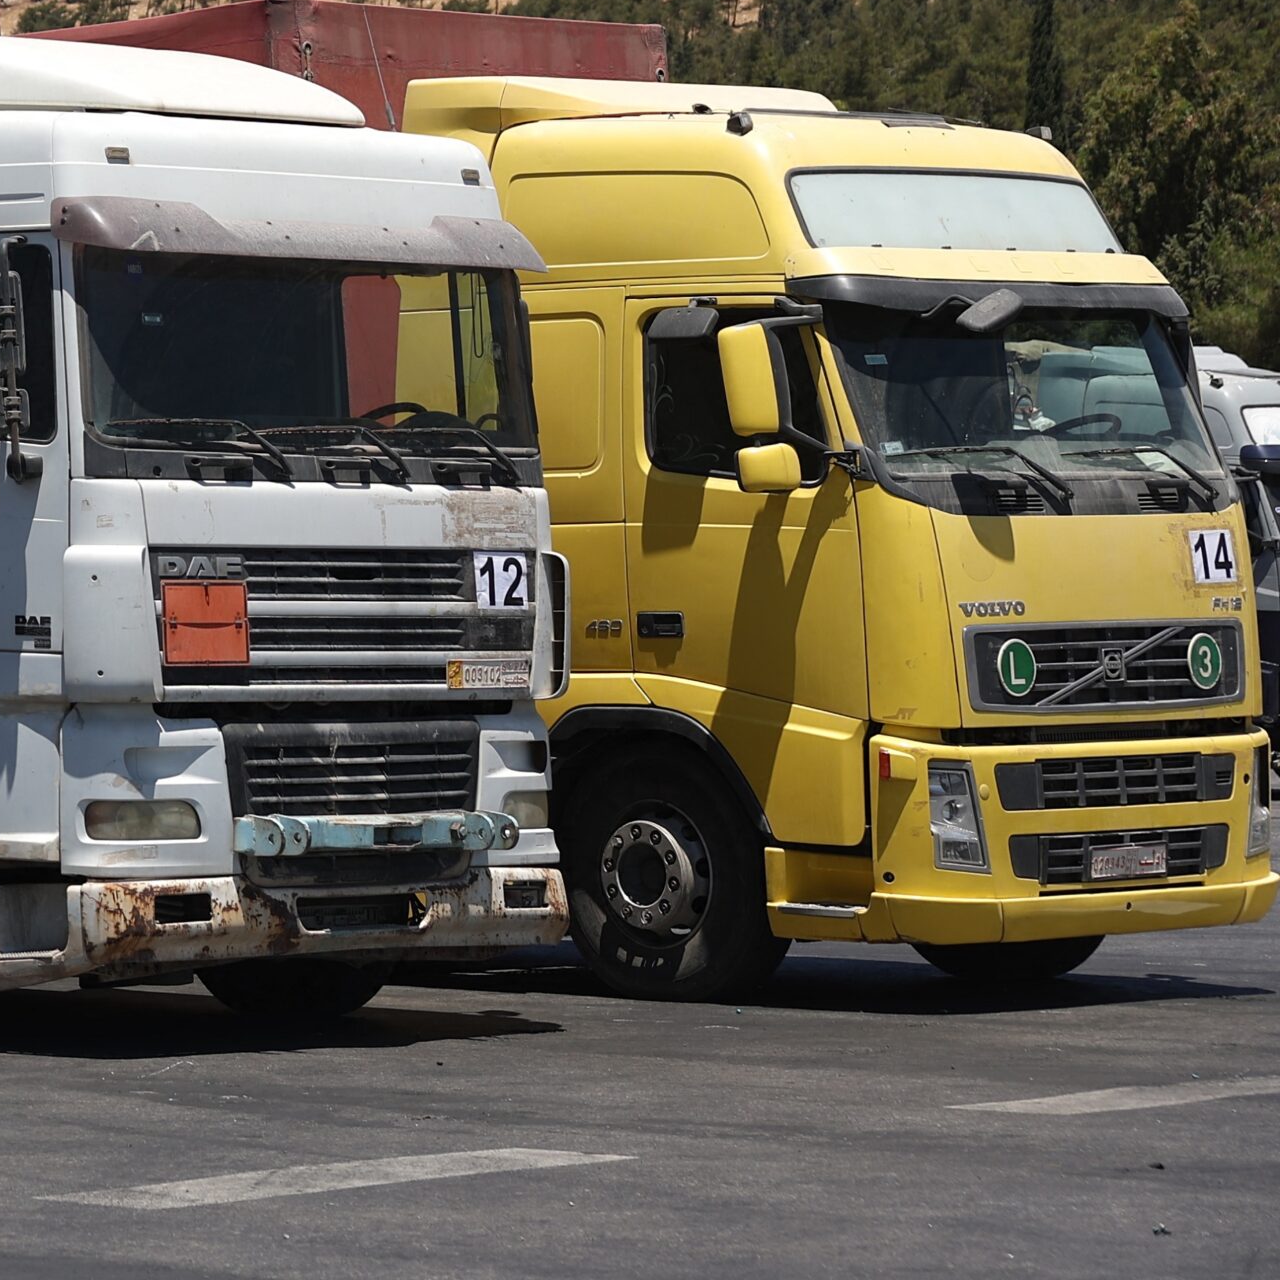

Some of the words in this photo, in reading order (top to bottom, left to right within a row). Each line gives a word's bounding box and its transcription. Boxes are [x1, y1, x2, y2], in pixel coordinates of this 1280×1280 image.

[157, 555, 242, 577] DAF
[1194, 532, 1233, 581] 14
[479, 557, 525, 607] 12
[15, 615, 52, 626] DAF
[958, 600, 1026, 618] VOLVO
[464, 666, 501, 684] 003102
[1010, 650, 1026, 686] L
[1198, 645, 1211, 678] 3
